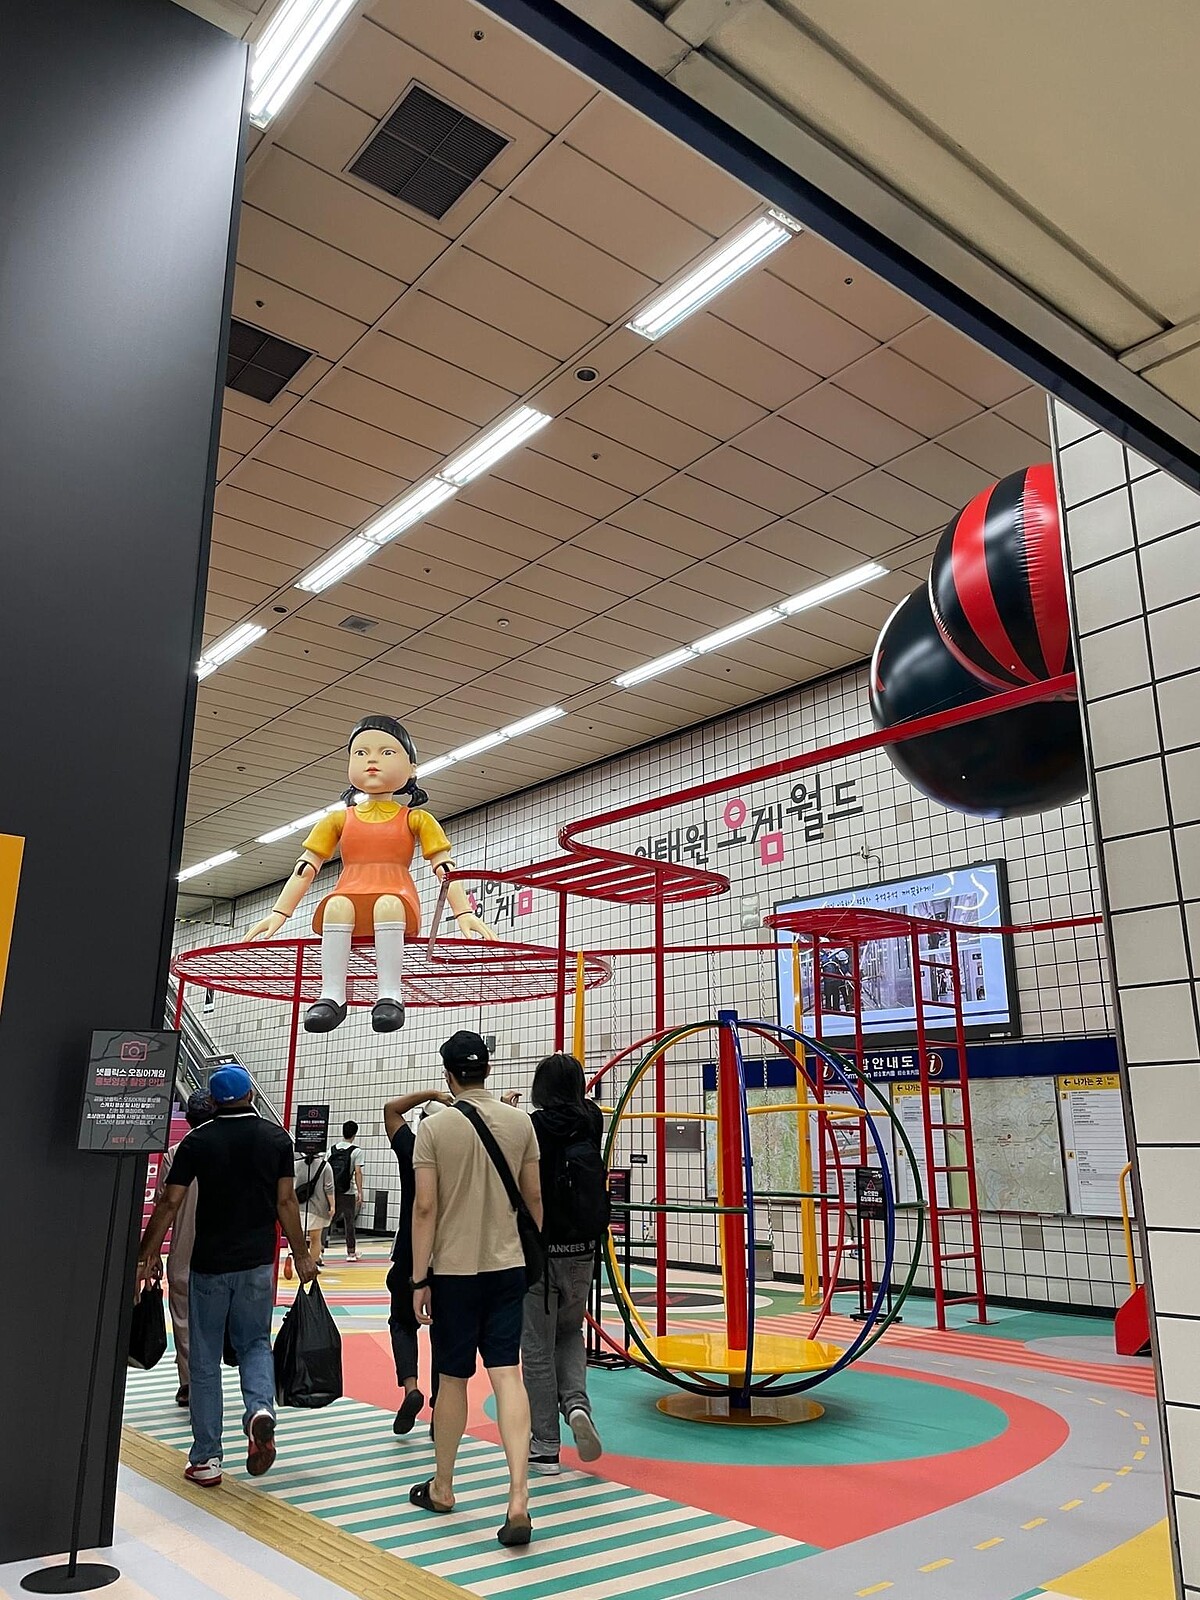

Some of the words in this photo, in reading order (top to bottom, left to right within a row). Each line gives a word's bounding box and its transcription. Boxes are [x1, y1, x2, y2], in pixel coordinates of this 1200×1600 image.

[634, 819, 709, 866] 이태원
[96, 1068, 127, 1077] 넷플릭스
[128, 1068, 166, 1078] 오징어게임
[148, 1078, 165, 1087] 안내
[1073, 1077, 1094, 1087] 나가는
